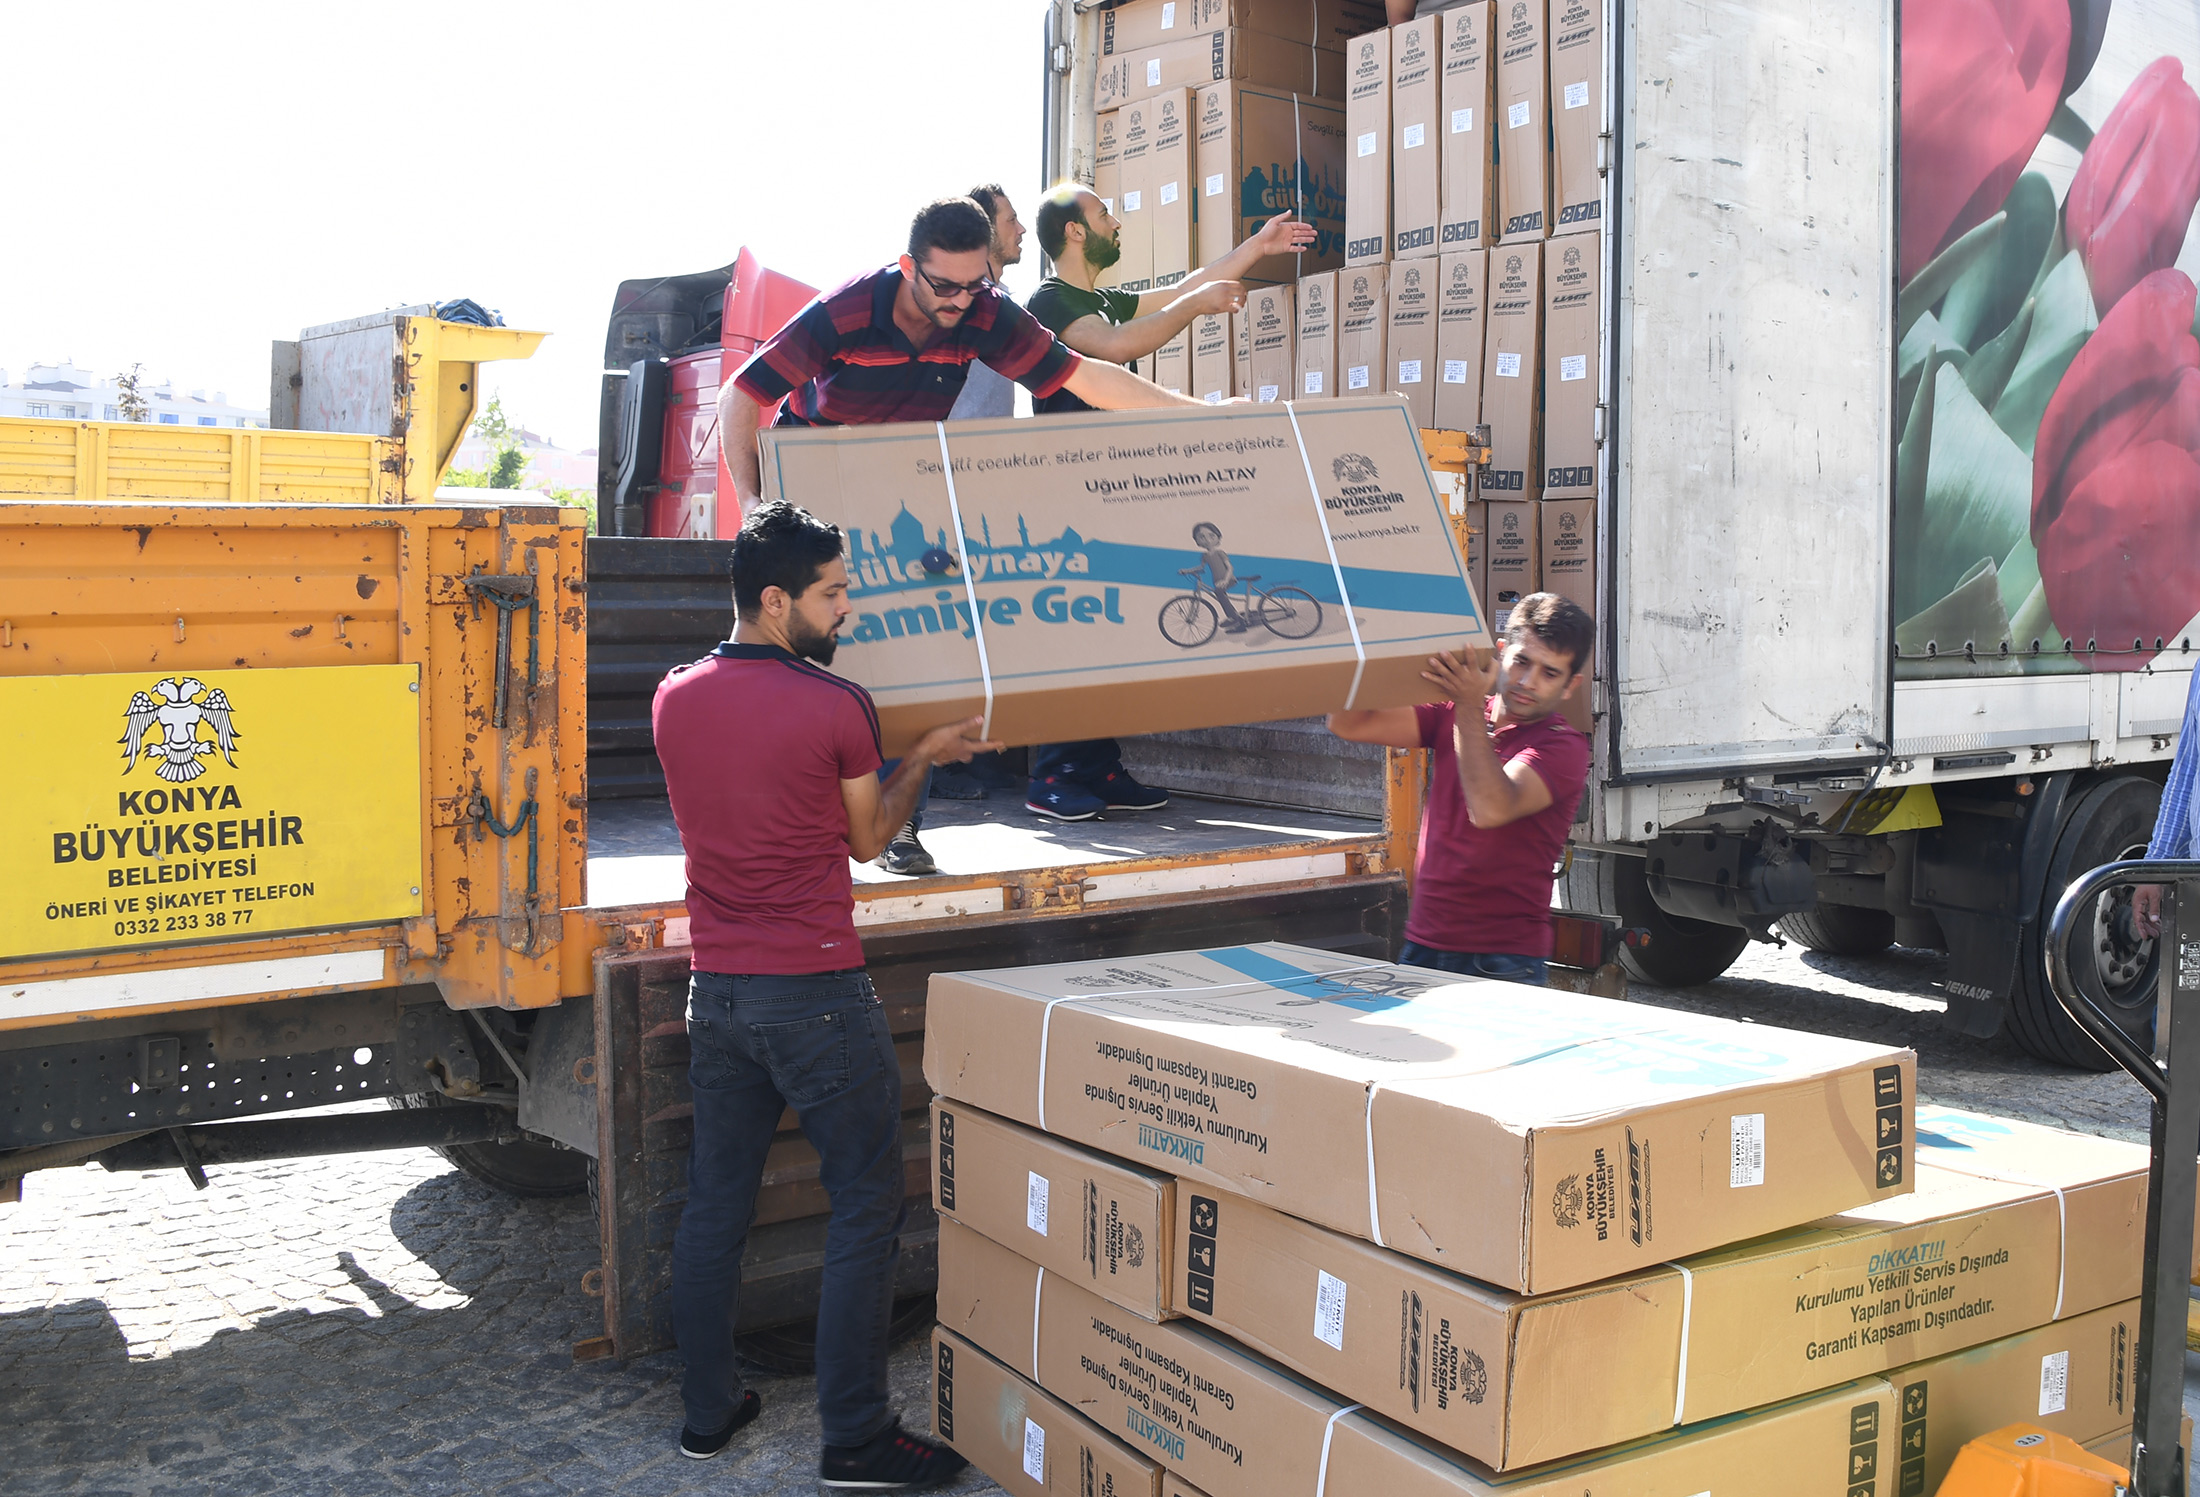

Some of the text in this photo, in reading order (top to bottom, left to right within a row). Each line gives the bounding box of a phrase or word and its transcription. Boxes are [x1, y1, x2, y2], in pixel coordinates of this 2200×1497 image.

[1307, 121, 1334, 136] Sevgili
[1056, 449, 1103, 464] sizler
[1108, 443, 1178, 461] ümmetin
[1085, 467, 1257, 495] Uğur İbrahim ALTAY
[1103, 495, 1130, 504] Konya
[1325, 491, 1405, 509] BÜYÜKŞEHİR
[1341, 484, 1382, 497] KONYA
[1331, 524, 1420, 541] www.konya.bel.tr
[1032, 585, 1125, 625] Gel
[119, 785, 242, 816] KONYA
[54, 810, 303, 863] BÜYÜKŞEHİR
[108, 853, 256, 888] BELEDİYESİ
[45, 882, 315, 920] ÖNERİ VE ŞİKAYET TELEFON
[114, 909, 253, 936] 0332 233 38 77
[1095, 1041, 1257, 1100] Garanti Kapsamı Dışındadır.
[1128, 1073, 1219, 1114] Yapılan Ürünler
[1085, 1083, 1267, 1154] Kurulumu Yetkili Servis Dışında
[1138, 1125, 1205, 1165] DİKKAT!!!
[1586, 1173, 1595, 1220] KONYA
[1594, 1147, 1608, 1241] BÜYÜKŞEHİR
[1607, 1165, 1615, 1219] BELEDİYESİ
[1109, 1200, 1119, 1275] BÜYÜKŞEHİR
[1868, 1240, 1946, 1274] DİKKAT!!!
[1795, 1248, 2009, 1313] Kurulumu Yetkili Servis Dışında
[1850, 1284, 1955, 1324] Yapılan Ürünler
[1805, 1298, 1994, 1361] Garanti Kapsamı Dışındadır.
[1091, 1316, 1235, 1411] Garanti Kapsamı Dışındadır.
[1431, 1333, 1439, 1388] BELEDİYESİ
[1437, 1318, 1452, 1410] BÜYÜKŞEHİR
[1449, 1345, 1458, 1391] KONYA
[1119, 1356, 1199, 1416] Yapılan Ürünler
[1080, 1355, 1243, 1467] Kurulumu Yetkili Servis Dışında
[1126, 1410, 1185, 1461] DİKKAT!!!
